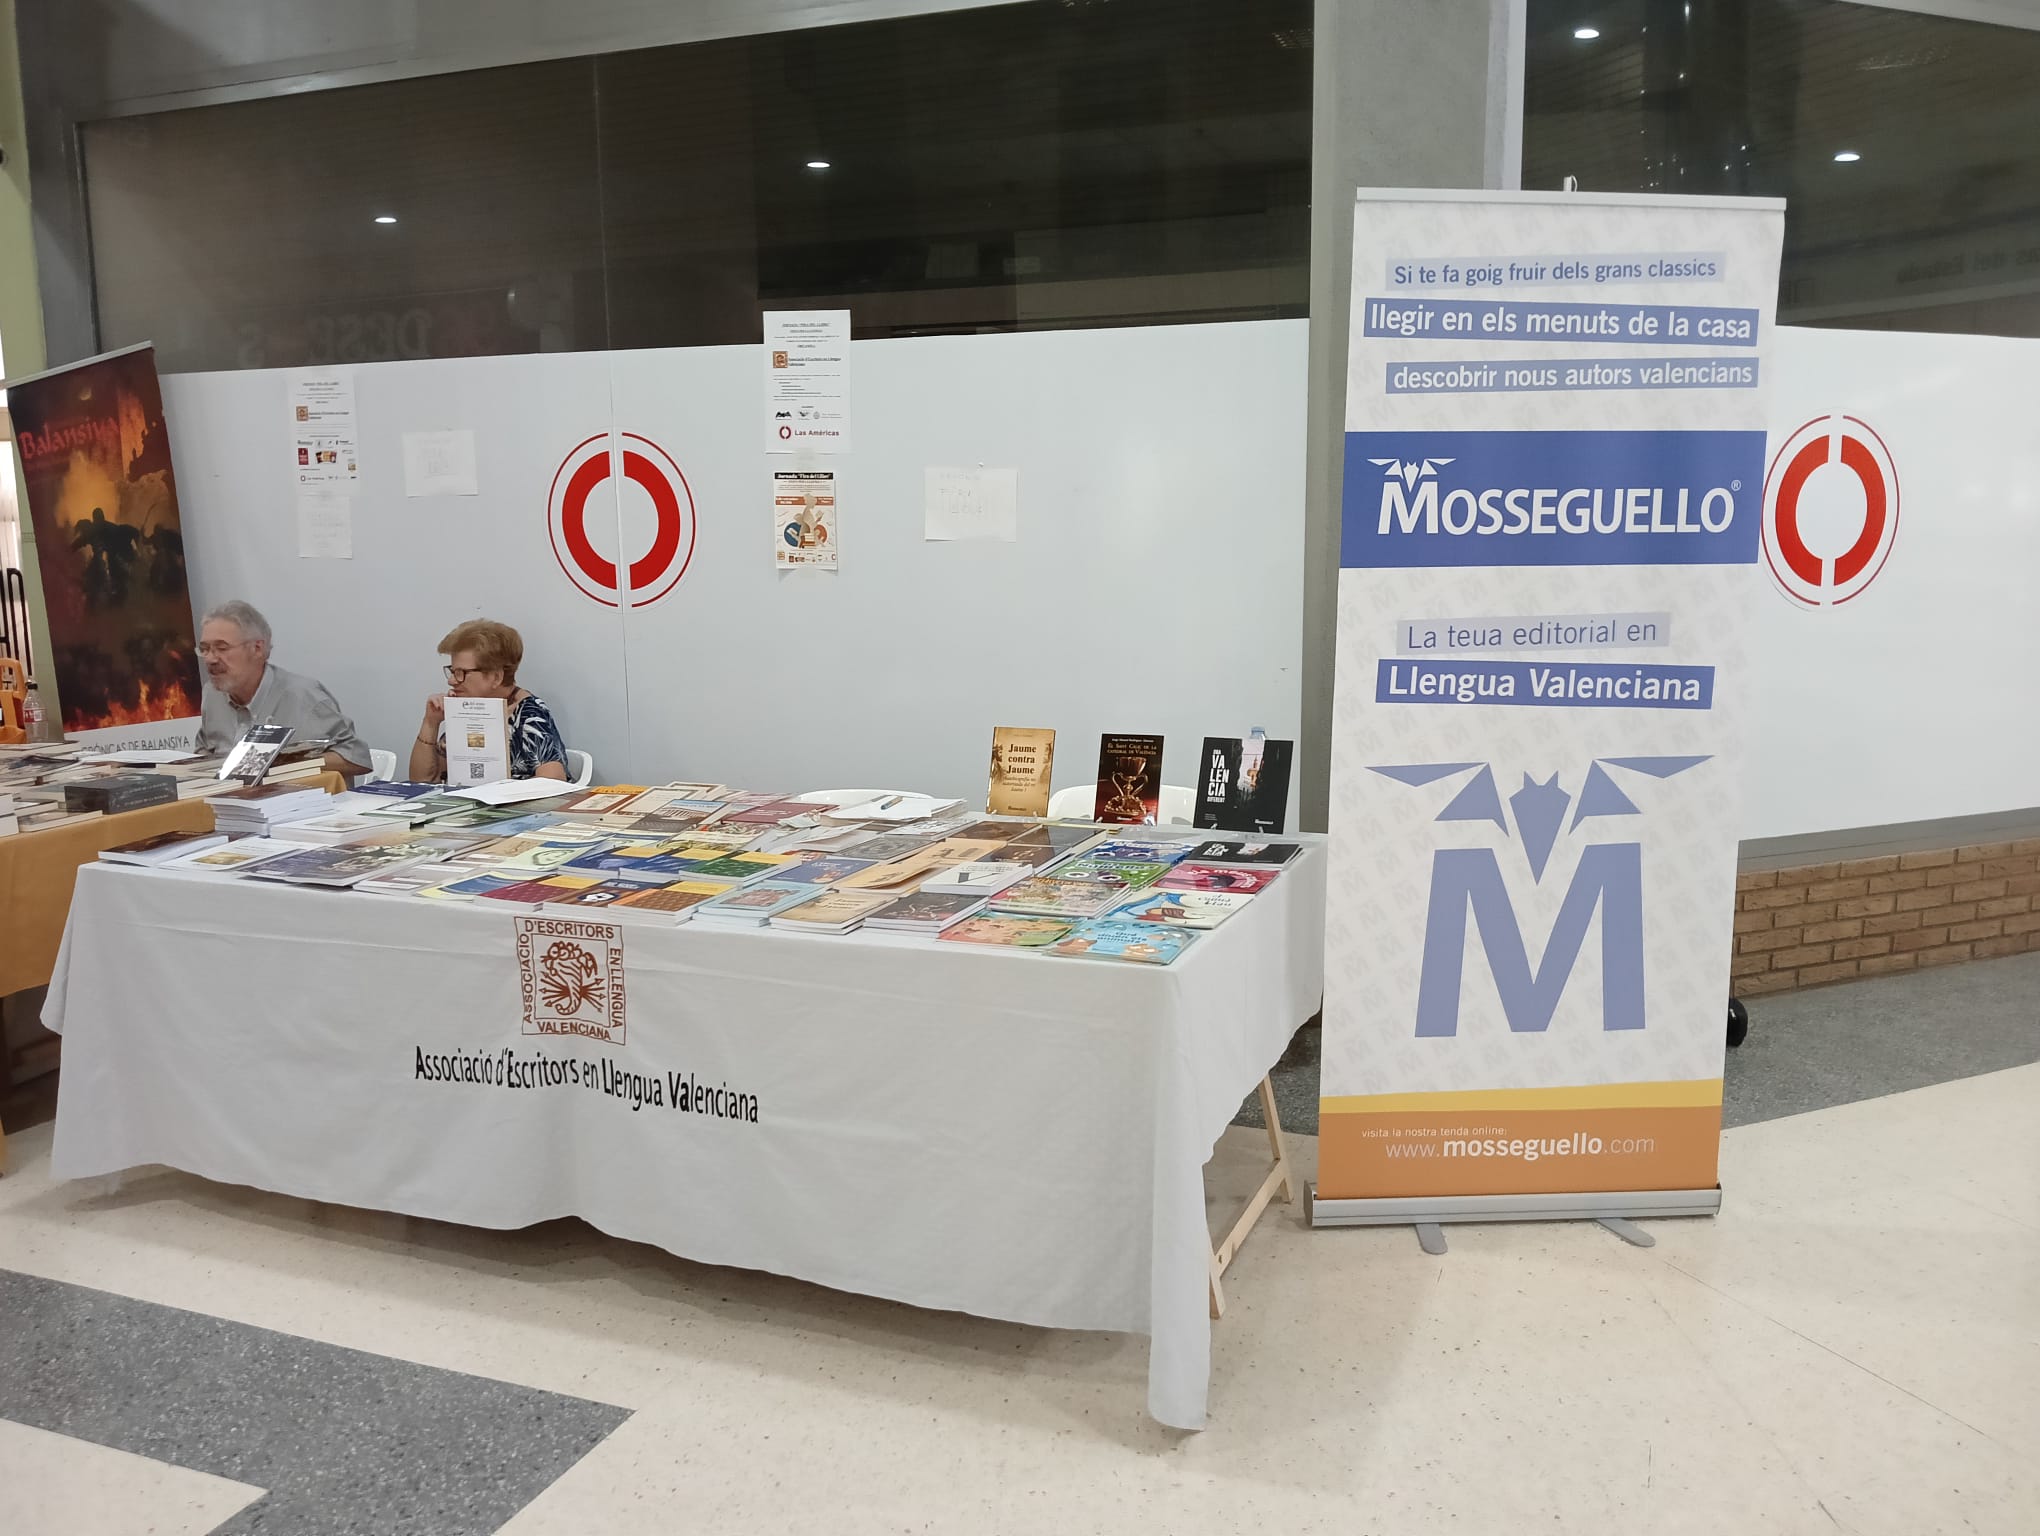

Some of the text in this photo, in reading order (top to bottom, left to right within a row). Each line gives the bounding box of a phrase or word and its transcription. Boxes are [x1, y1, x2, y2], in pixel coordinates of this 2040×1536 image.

[1395, 260, 1716, 285] Si te fa goig fruir dels grans classics
[1371, 304, 1750, 337] llegir en els menuts de la casa
[1393, 362, 1752, 389] descobrir nous autors valencians
[1377, 481, 1734, 535] MOSSEGUELLO
[1407, 620, 1657, 649] La teua editorial en
[1389, 666, 1701, 702] Llengua Valenciana
[1009, 744, 1036, 752] Jaume
[1007, 765, 1034, 774] Jaume
[525, 920, 614, 939] D'ESCRITORS
[610, 948, 623, 1028] EN LLENGUA
[537, 1021, 611, 1040] VALENCIANA
[415, 1045, 493, 1085] Associació
[583, 1060, 599, 1090] en
[602, 1057, 664, 1112] Llengua
[668, 1071, 759, 1124] Valenciana
[1362, 1127, 1389, 1138] visita
[1392, 1127, 1401, 1137] la
[1405, 1128, 1437, 1137] nostra
[1440, 1126, 1469, 1136] tenda
[1386, 1133, 1655, 1161] www.mosseguello.com
